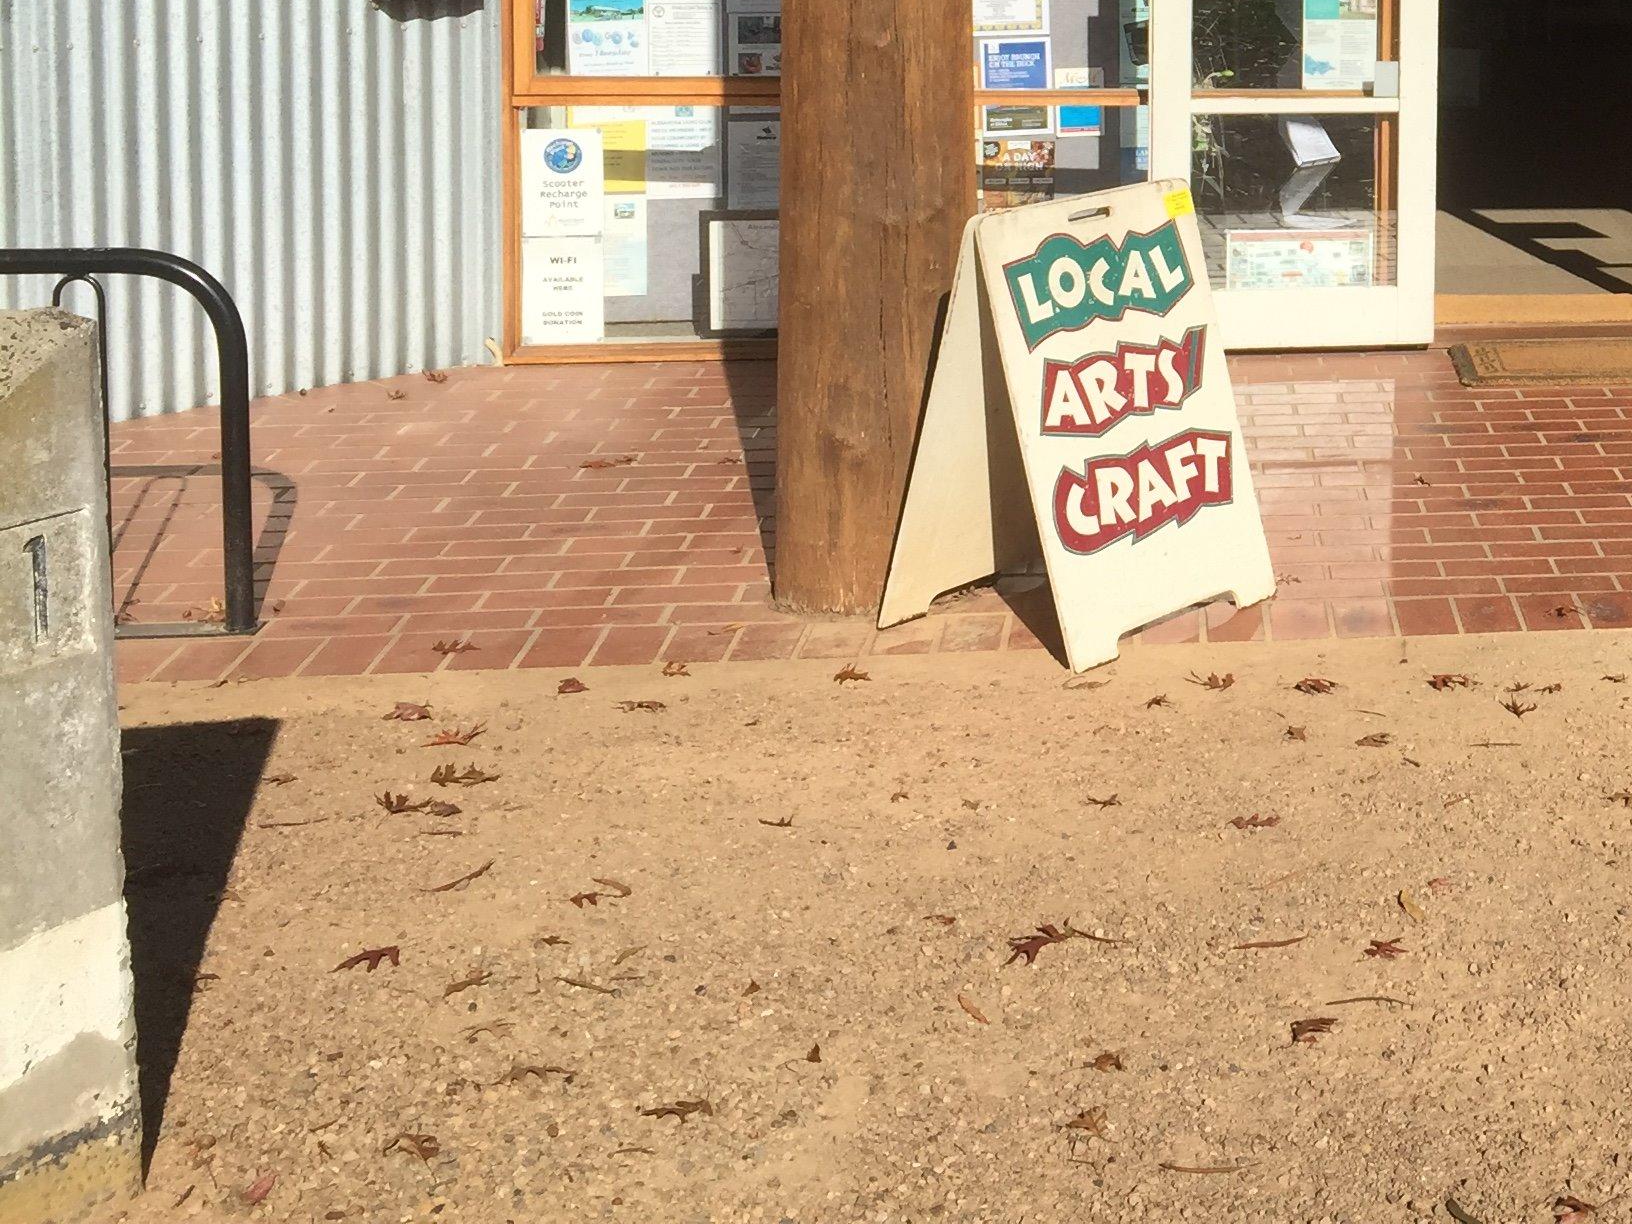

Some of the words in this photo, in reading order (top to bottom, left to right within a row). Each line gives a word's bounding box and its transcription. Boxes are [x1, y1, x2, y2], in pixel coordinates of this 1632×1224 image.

[542, 180, 585, 188] Scooter
[540, 189, 588, 199] Recharge
[549, 200, 579, 208] Point
[1018, 244, 1185, 324] LOCAL
[1065, 436, 1227, 536] CRAFT
